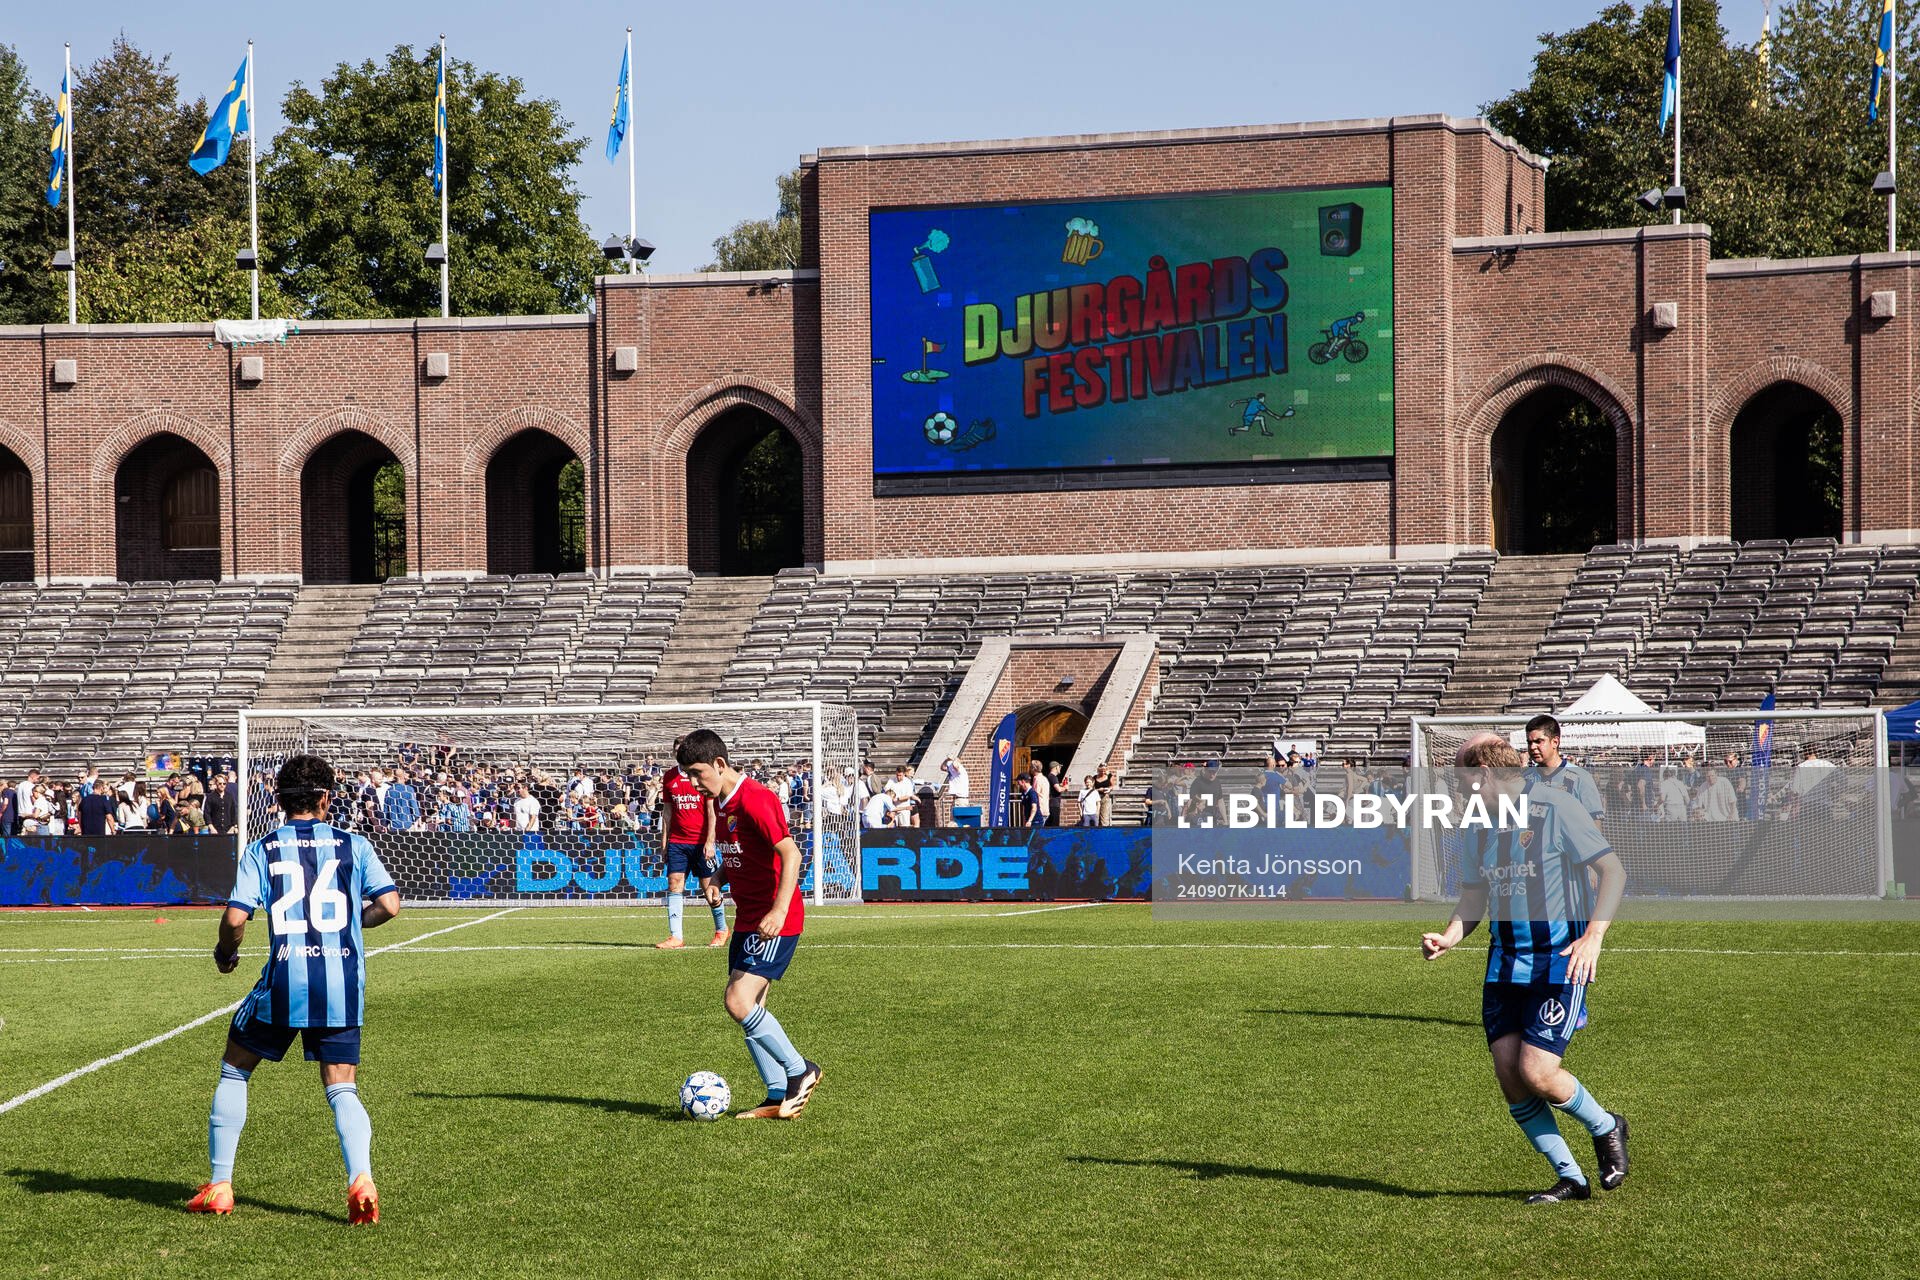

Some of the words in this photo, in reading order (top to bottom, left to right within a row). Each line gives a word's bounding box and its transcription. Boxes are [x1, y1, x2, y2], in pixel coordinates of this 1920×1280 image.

[963, 247, 1289, 366] DJURGÅRDS
[1022, 312, 1289, 418] FESTIVALEN
[1000, 771, 1007, 782] IF
[269, 859, 348, 935] 26
[295, 945, 320, 957] NRC
[321, 945, 350, 958] Group
